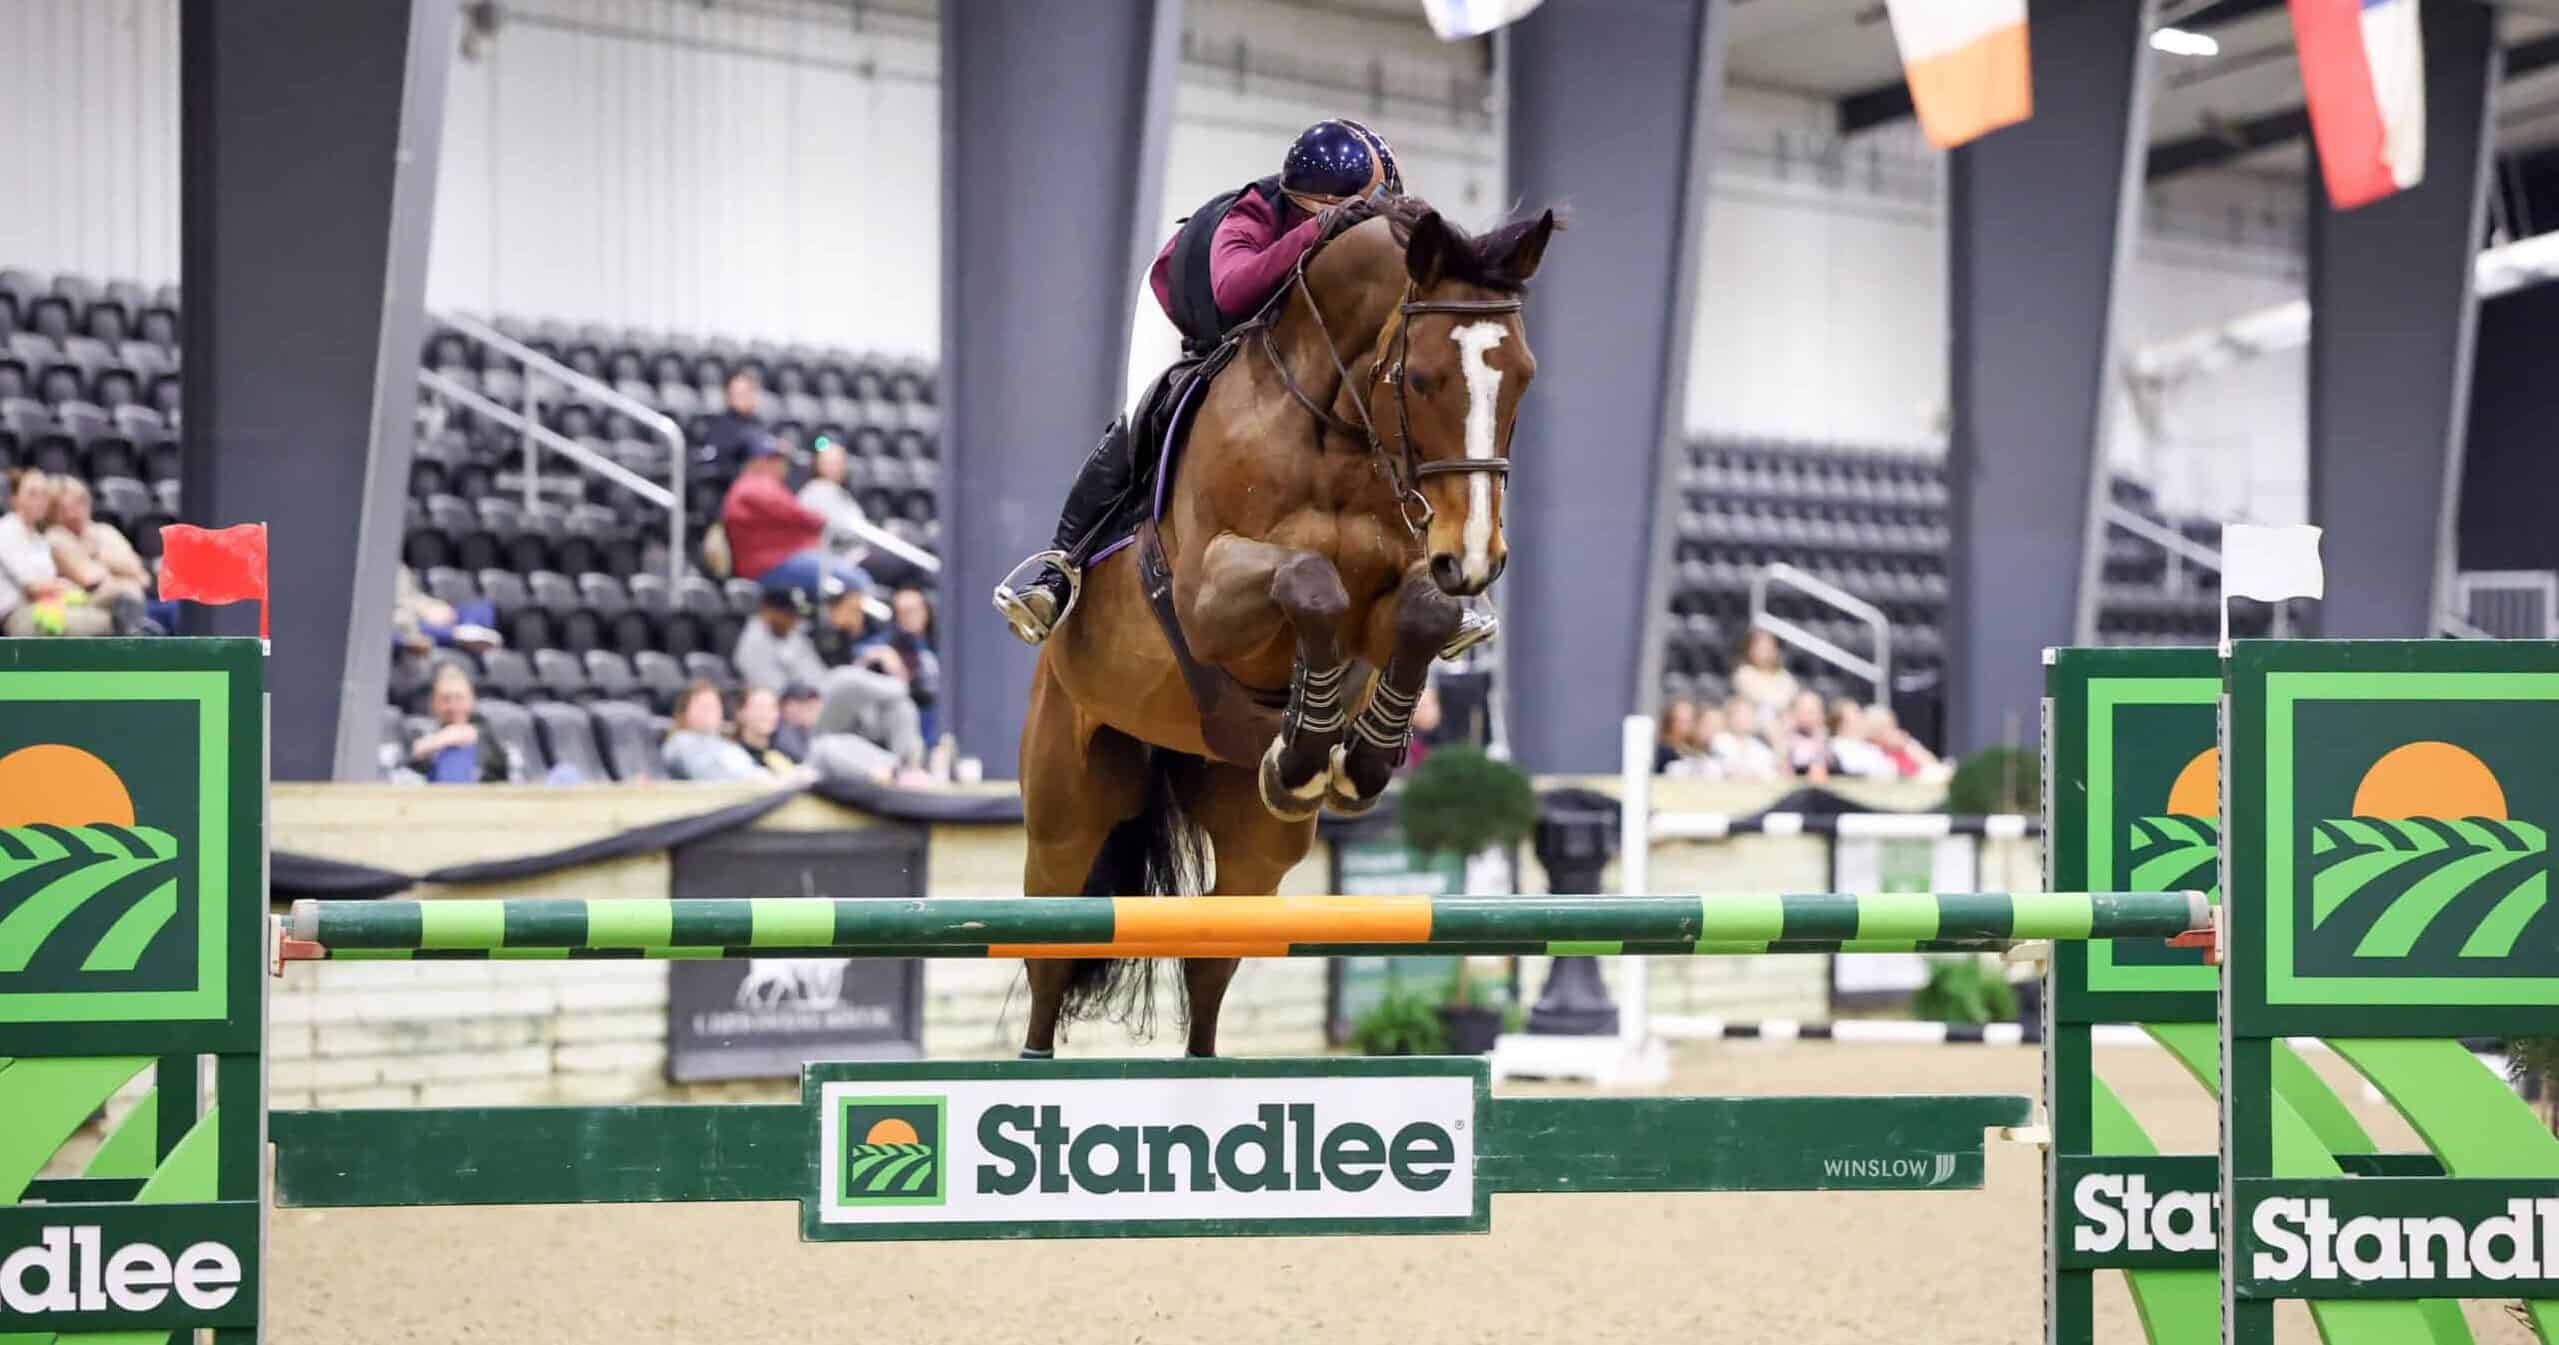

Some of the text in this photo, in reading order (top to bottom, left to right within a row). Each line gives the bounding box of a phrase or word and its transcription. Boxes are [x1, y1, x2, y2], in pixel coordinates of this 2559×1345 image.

[976, 1103, 1455, 1196] Standlee
[1823, 1159, 1928, 1178] WINSLOW
[2074, 1173, 2218, 1253] Sta
[2252, 1196, 2559, 1281] Standl
[0, 1225, 242, 1314] dlee
